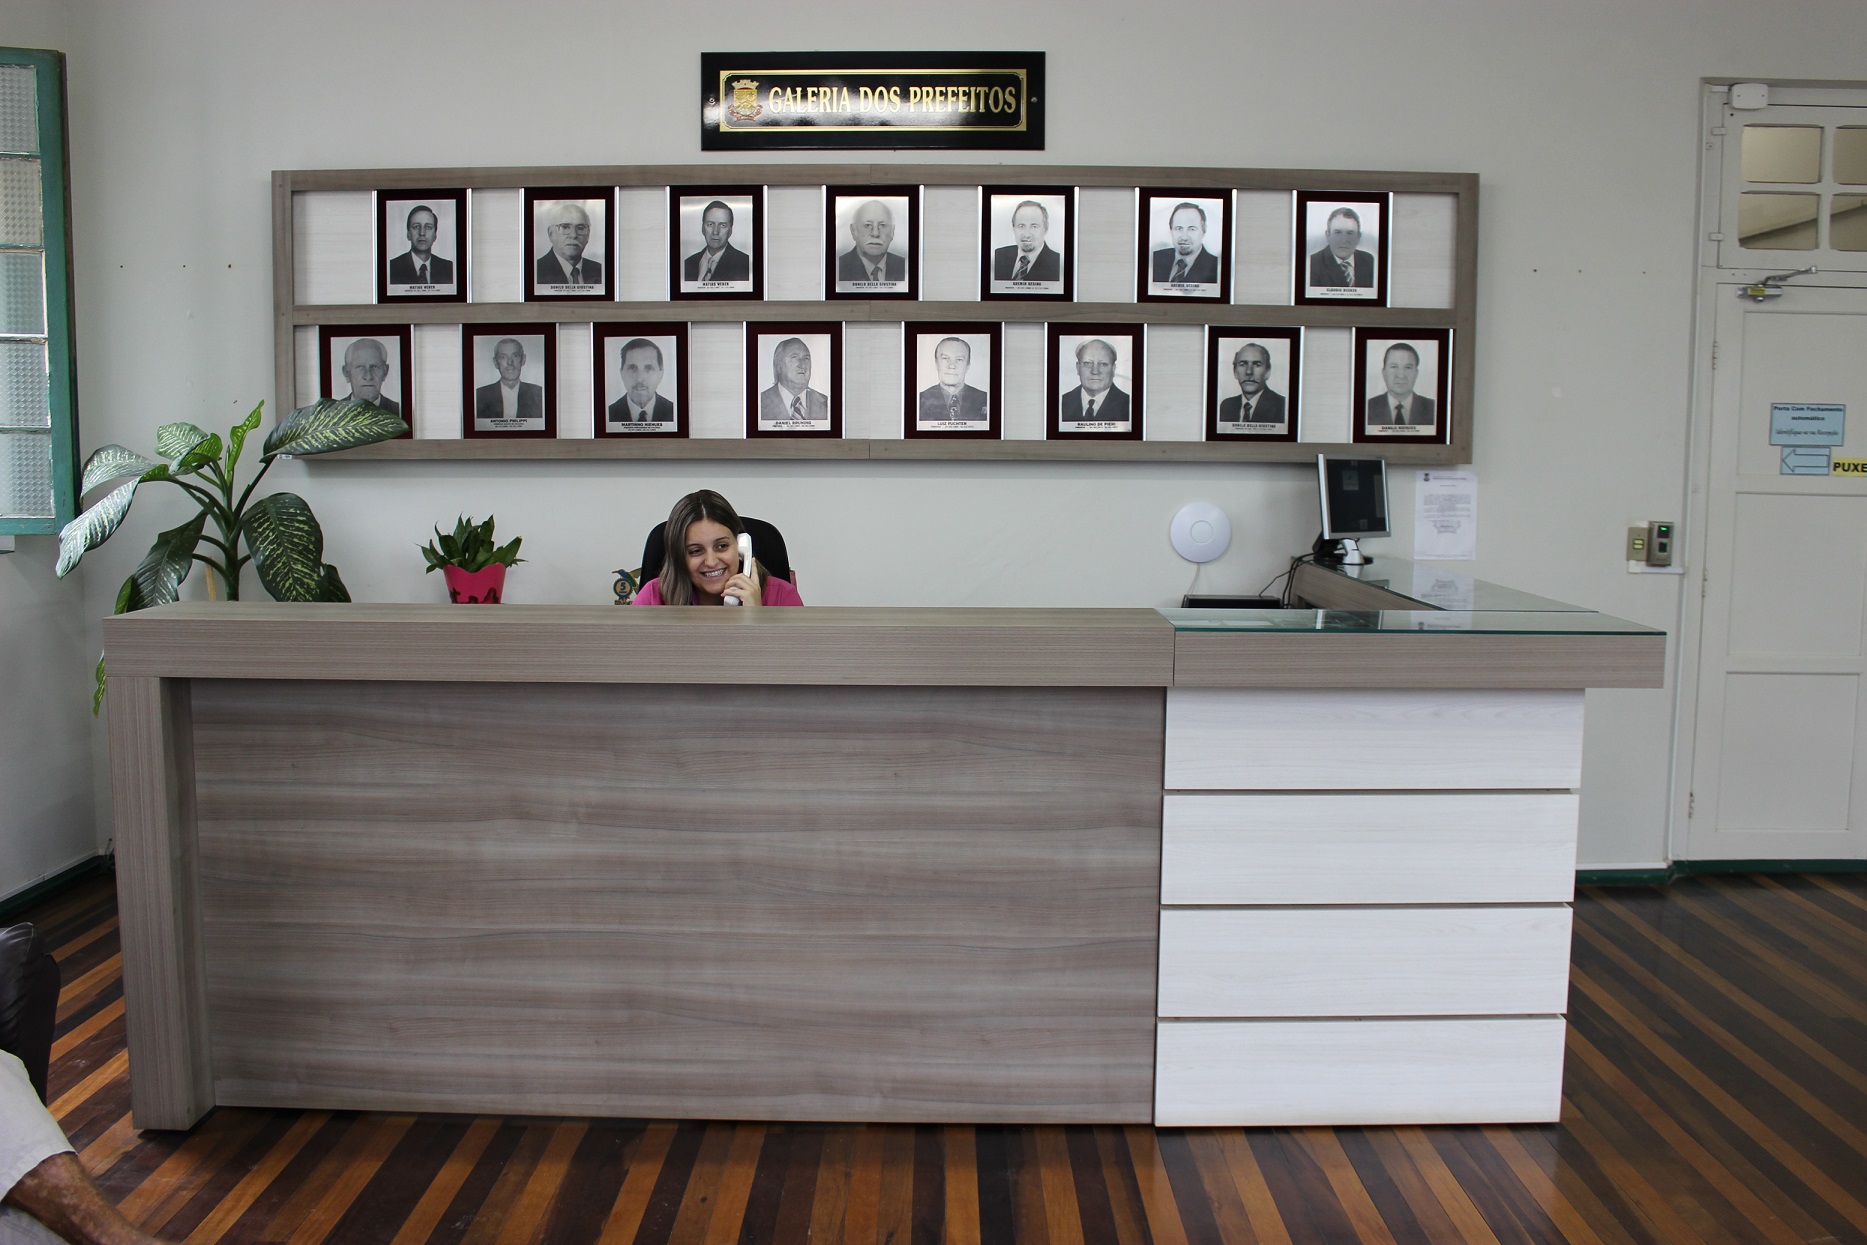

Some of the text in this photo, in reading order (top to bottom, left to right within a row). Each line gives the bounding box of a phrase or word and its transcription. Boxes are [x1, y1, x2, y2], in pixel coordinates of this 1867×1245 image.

[768, 86, 851, 113] GALERIA
[859, 86, 901, 113] DOS
[909, 86, 1017, 113] PREFEITOS
[1833, 462, 1867, 473] PUXE
